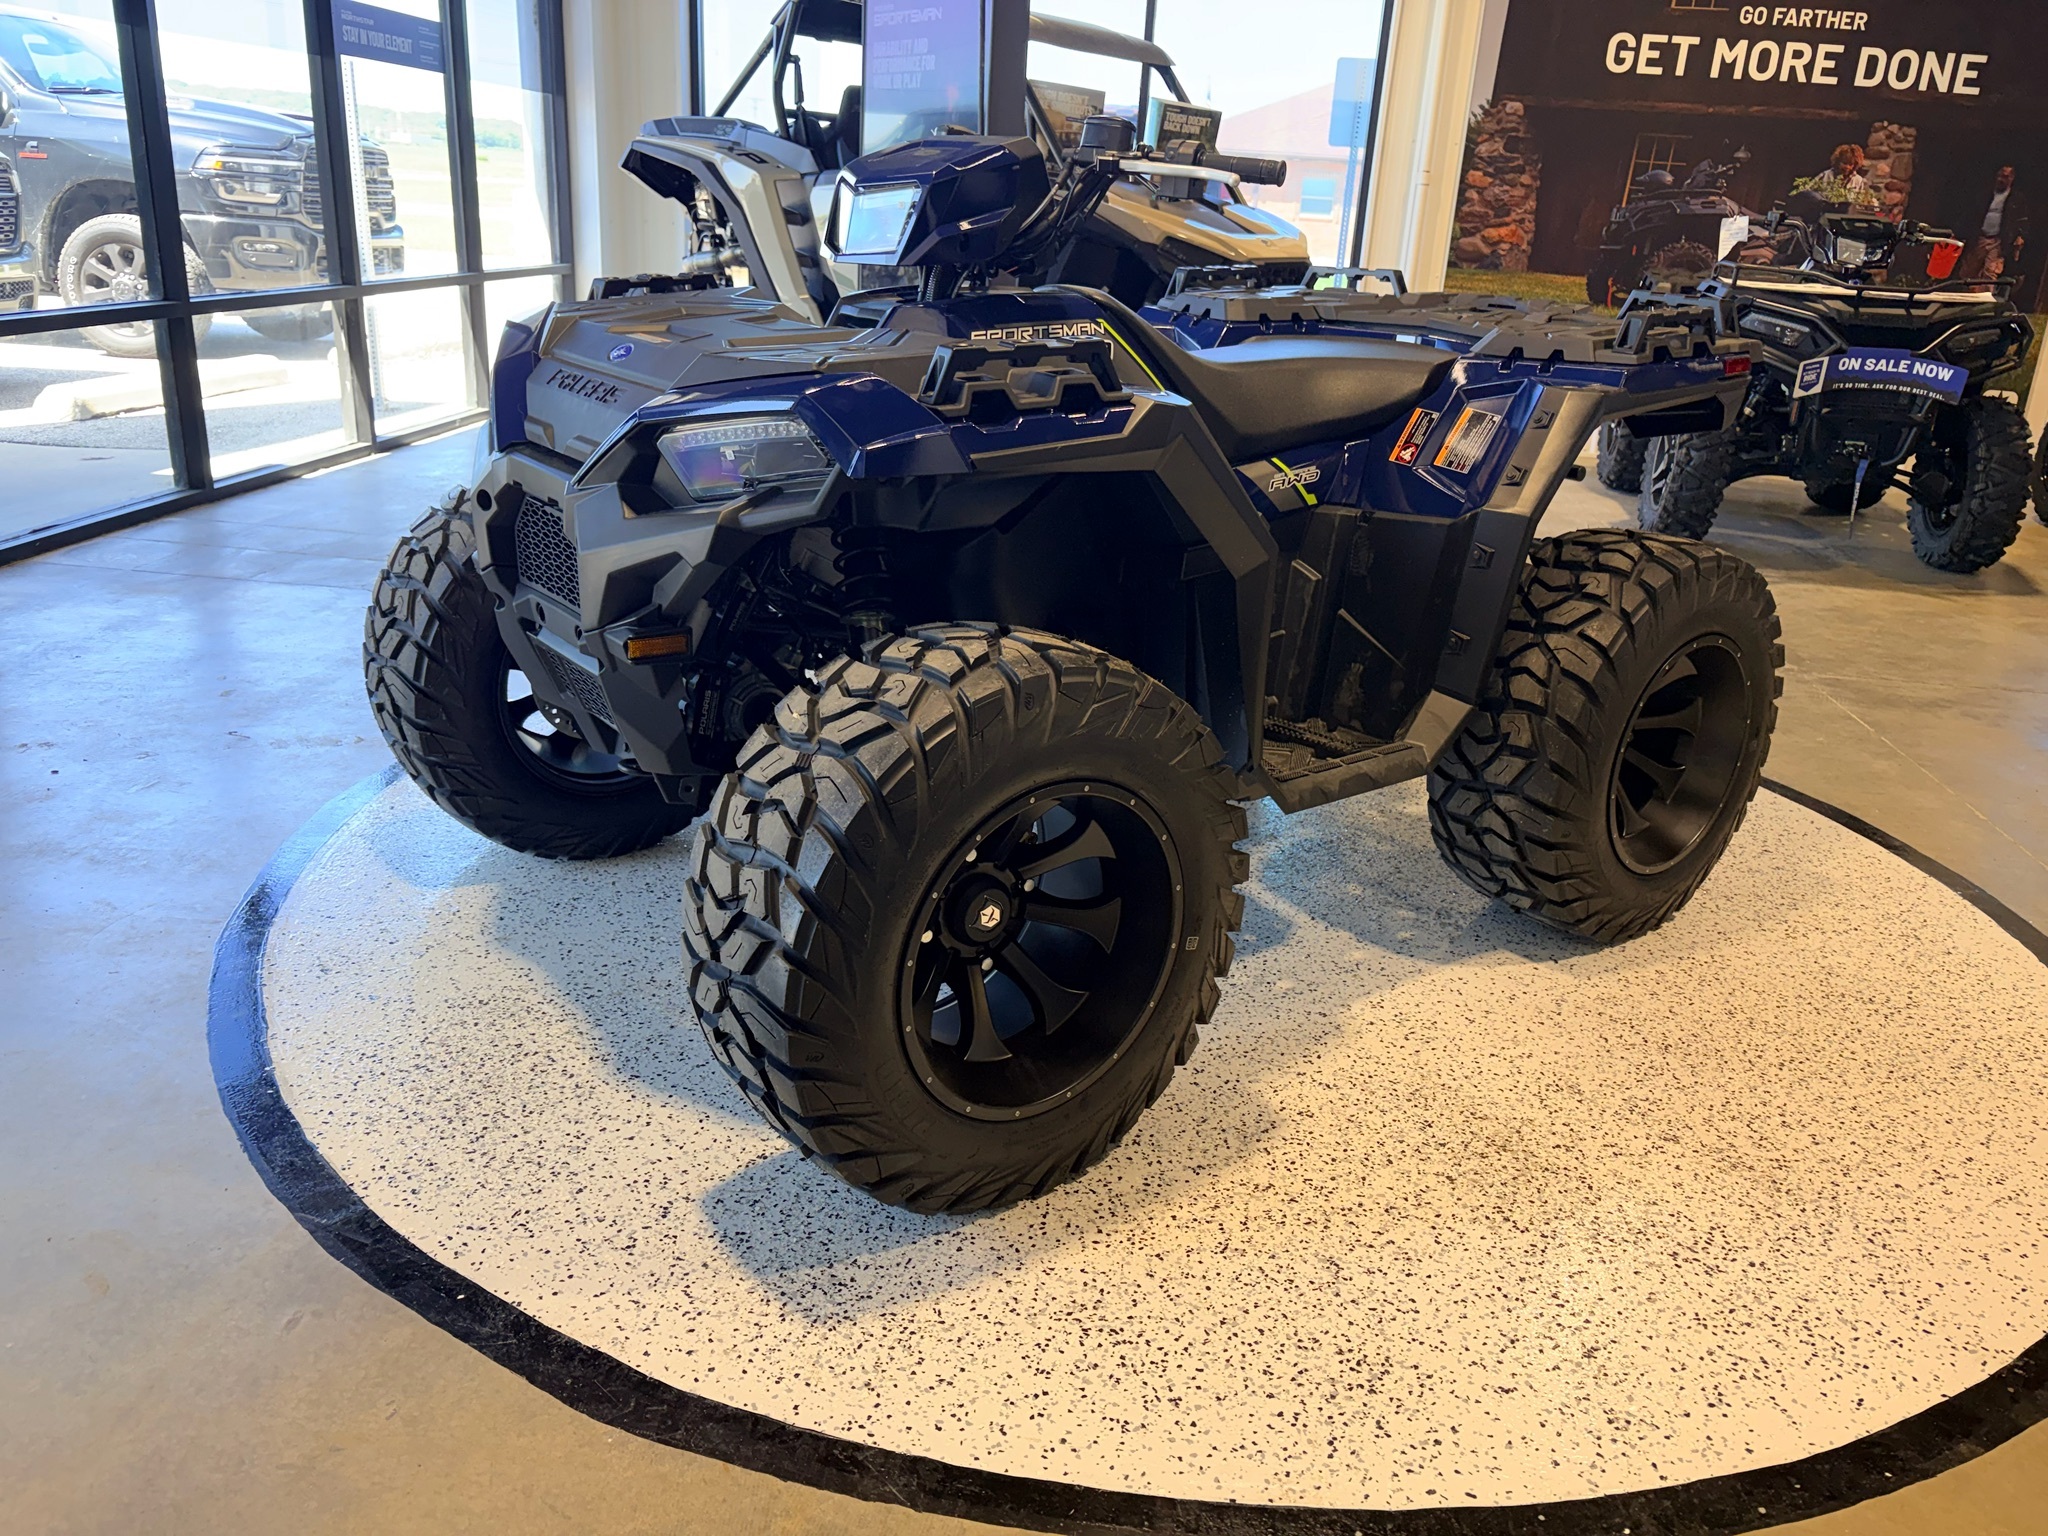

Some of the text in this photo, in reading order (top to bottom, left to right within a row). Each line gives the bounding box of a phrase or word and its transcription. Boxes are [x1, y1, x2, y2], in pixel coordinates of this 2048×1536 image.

[874, 6, 943, 27] SPORTSMAN
[1739, 6, 1869, 31] GO FARTHER
[342, 25, 359, 43] STAY
[360, 28, 368, 46] IN
[367, 30, 385, 49] YOUR
[385, 34, 413, 54] ELEMENT
[921, 54, 936, 71] FOR
[1605, 32, 1989, 96] GET MORE DONE
[1163, 120, 1182, 132] BACK
[1166, 111, 1188, 124] TOUGH
[971, 322, 1105, 341] SPORTSMAN
[1838, 357, 1862, 371] ON
[1864, 357, 1911, 373] SALE
[1912, 363, 1955, 382] NOW
[546, 368, 628, 404] POLARIS
[1899, 385, 1911, 393] OUR
[1912, 388, 1928, 396] BEST
[1929, 391, 1945, 401] DEAL.
[1268, 469, 1321, 493] AWD
[699, 689, 712, 735] POLARIS
